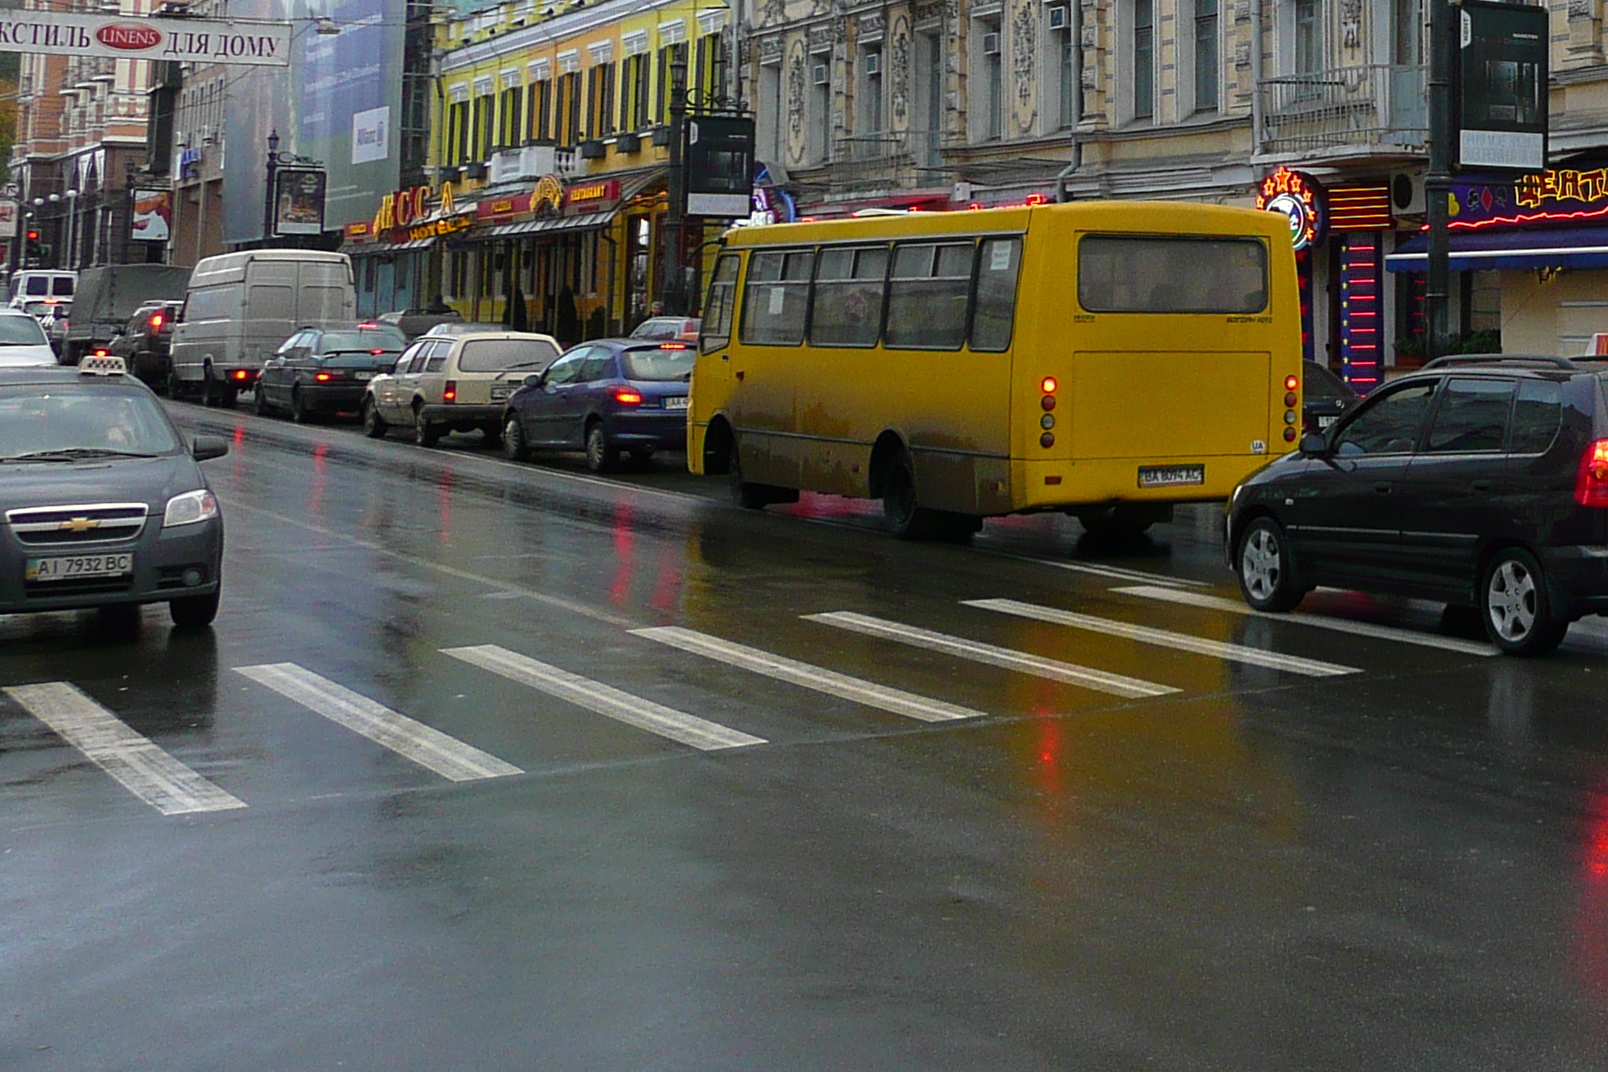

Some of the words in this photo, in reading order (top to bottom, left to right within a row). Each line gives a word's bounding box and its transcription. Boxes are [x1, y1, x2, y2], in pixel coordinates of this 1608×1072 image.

[0, 21, 91, 48] КСТИЛЬ
[102, 29, 157, 45] LINENS
[163, 31, 209, 56] ДЛЯ
[214, 34, 280, 57] ДОМУ
[64, 557, 102, 573] 7932
[105, 555, 128, 571] BC
